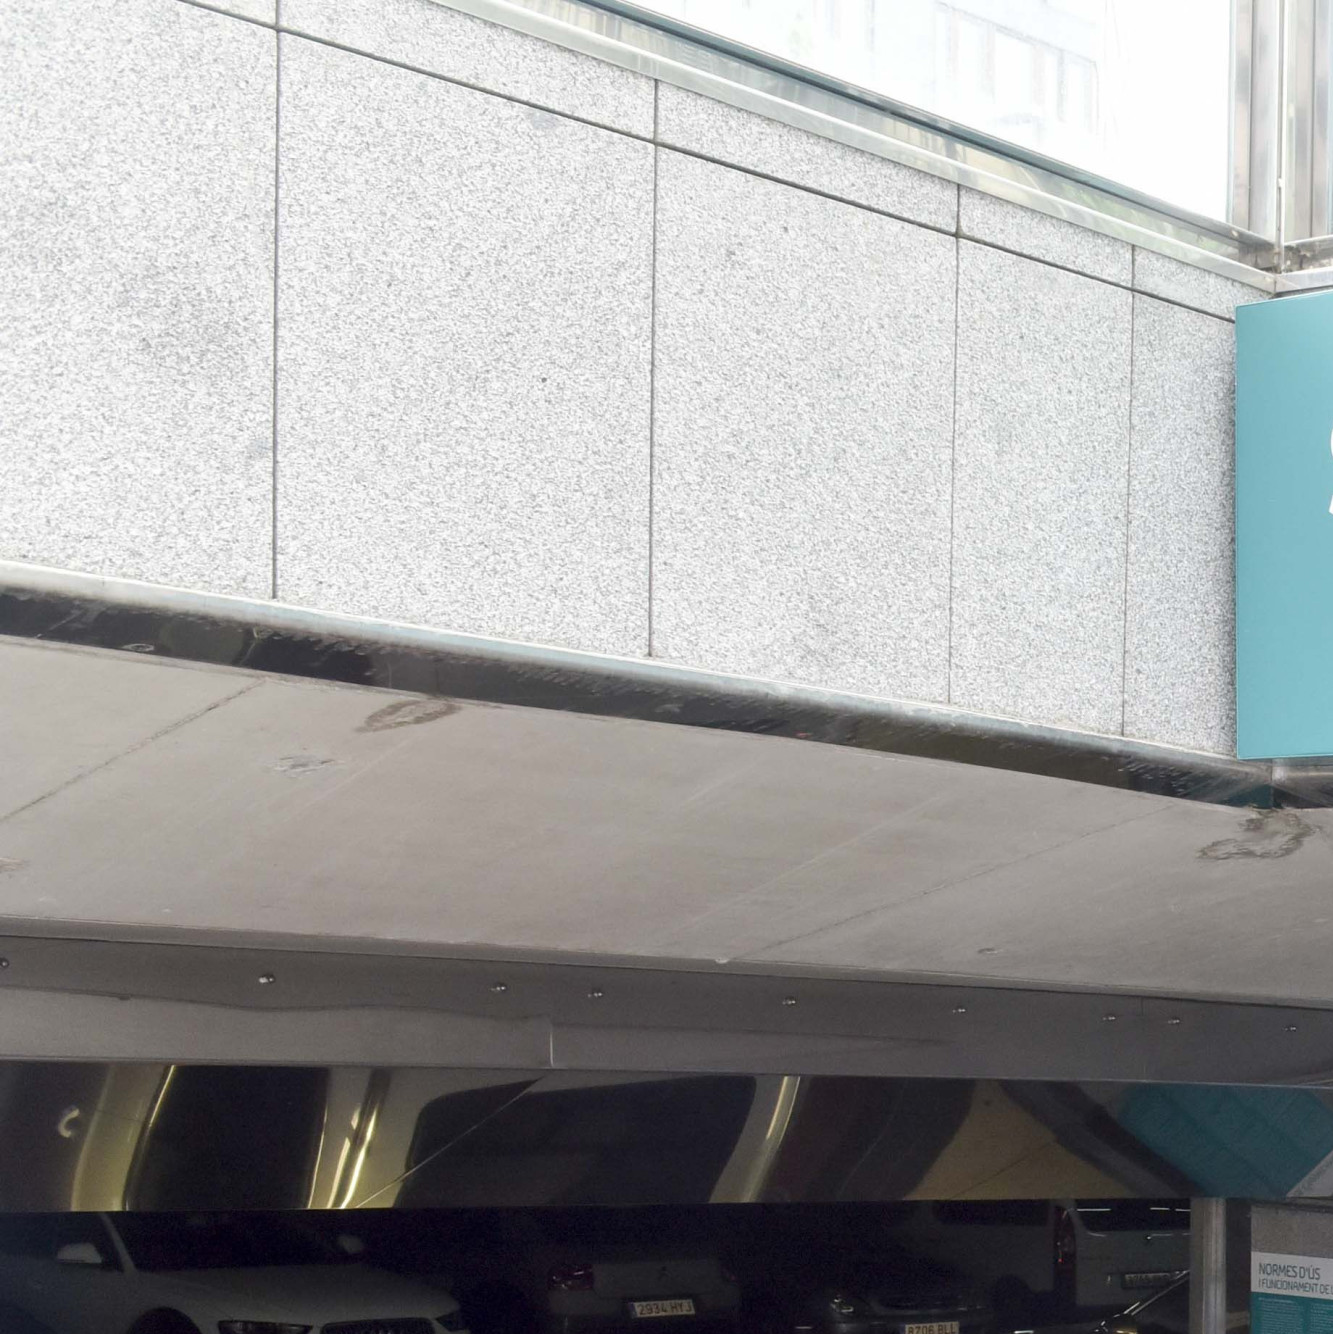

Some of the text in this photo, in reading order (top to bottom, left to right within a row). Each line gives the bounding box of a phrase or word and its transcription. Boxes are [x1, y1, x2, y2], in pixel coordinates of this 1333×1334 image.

[1258, 1262, 1321, 1280] NORMES D'ÚS
[1262, 1278, 1319, 1293] FUNCIONAMENT
[1320, 1284, 1331, 1295] DE
[937, 1322, 957, 1334] BLL
